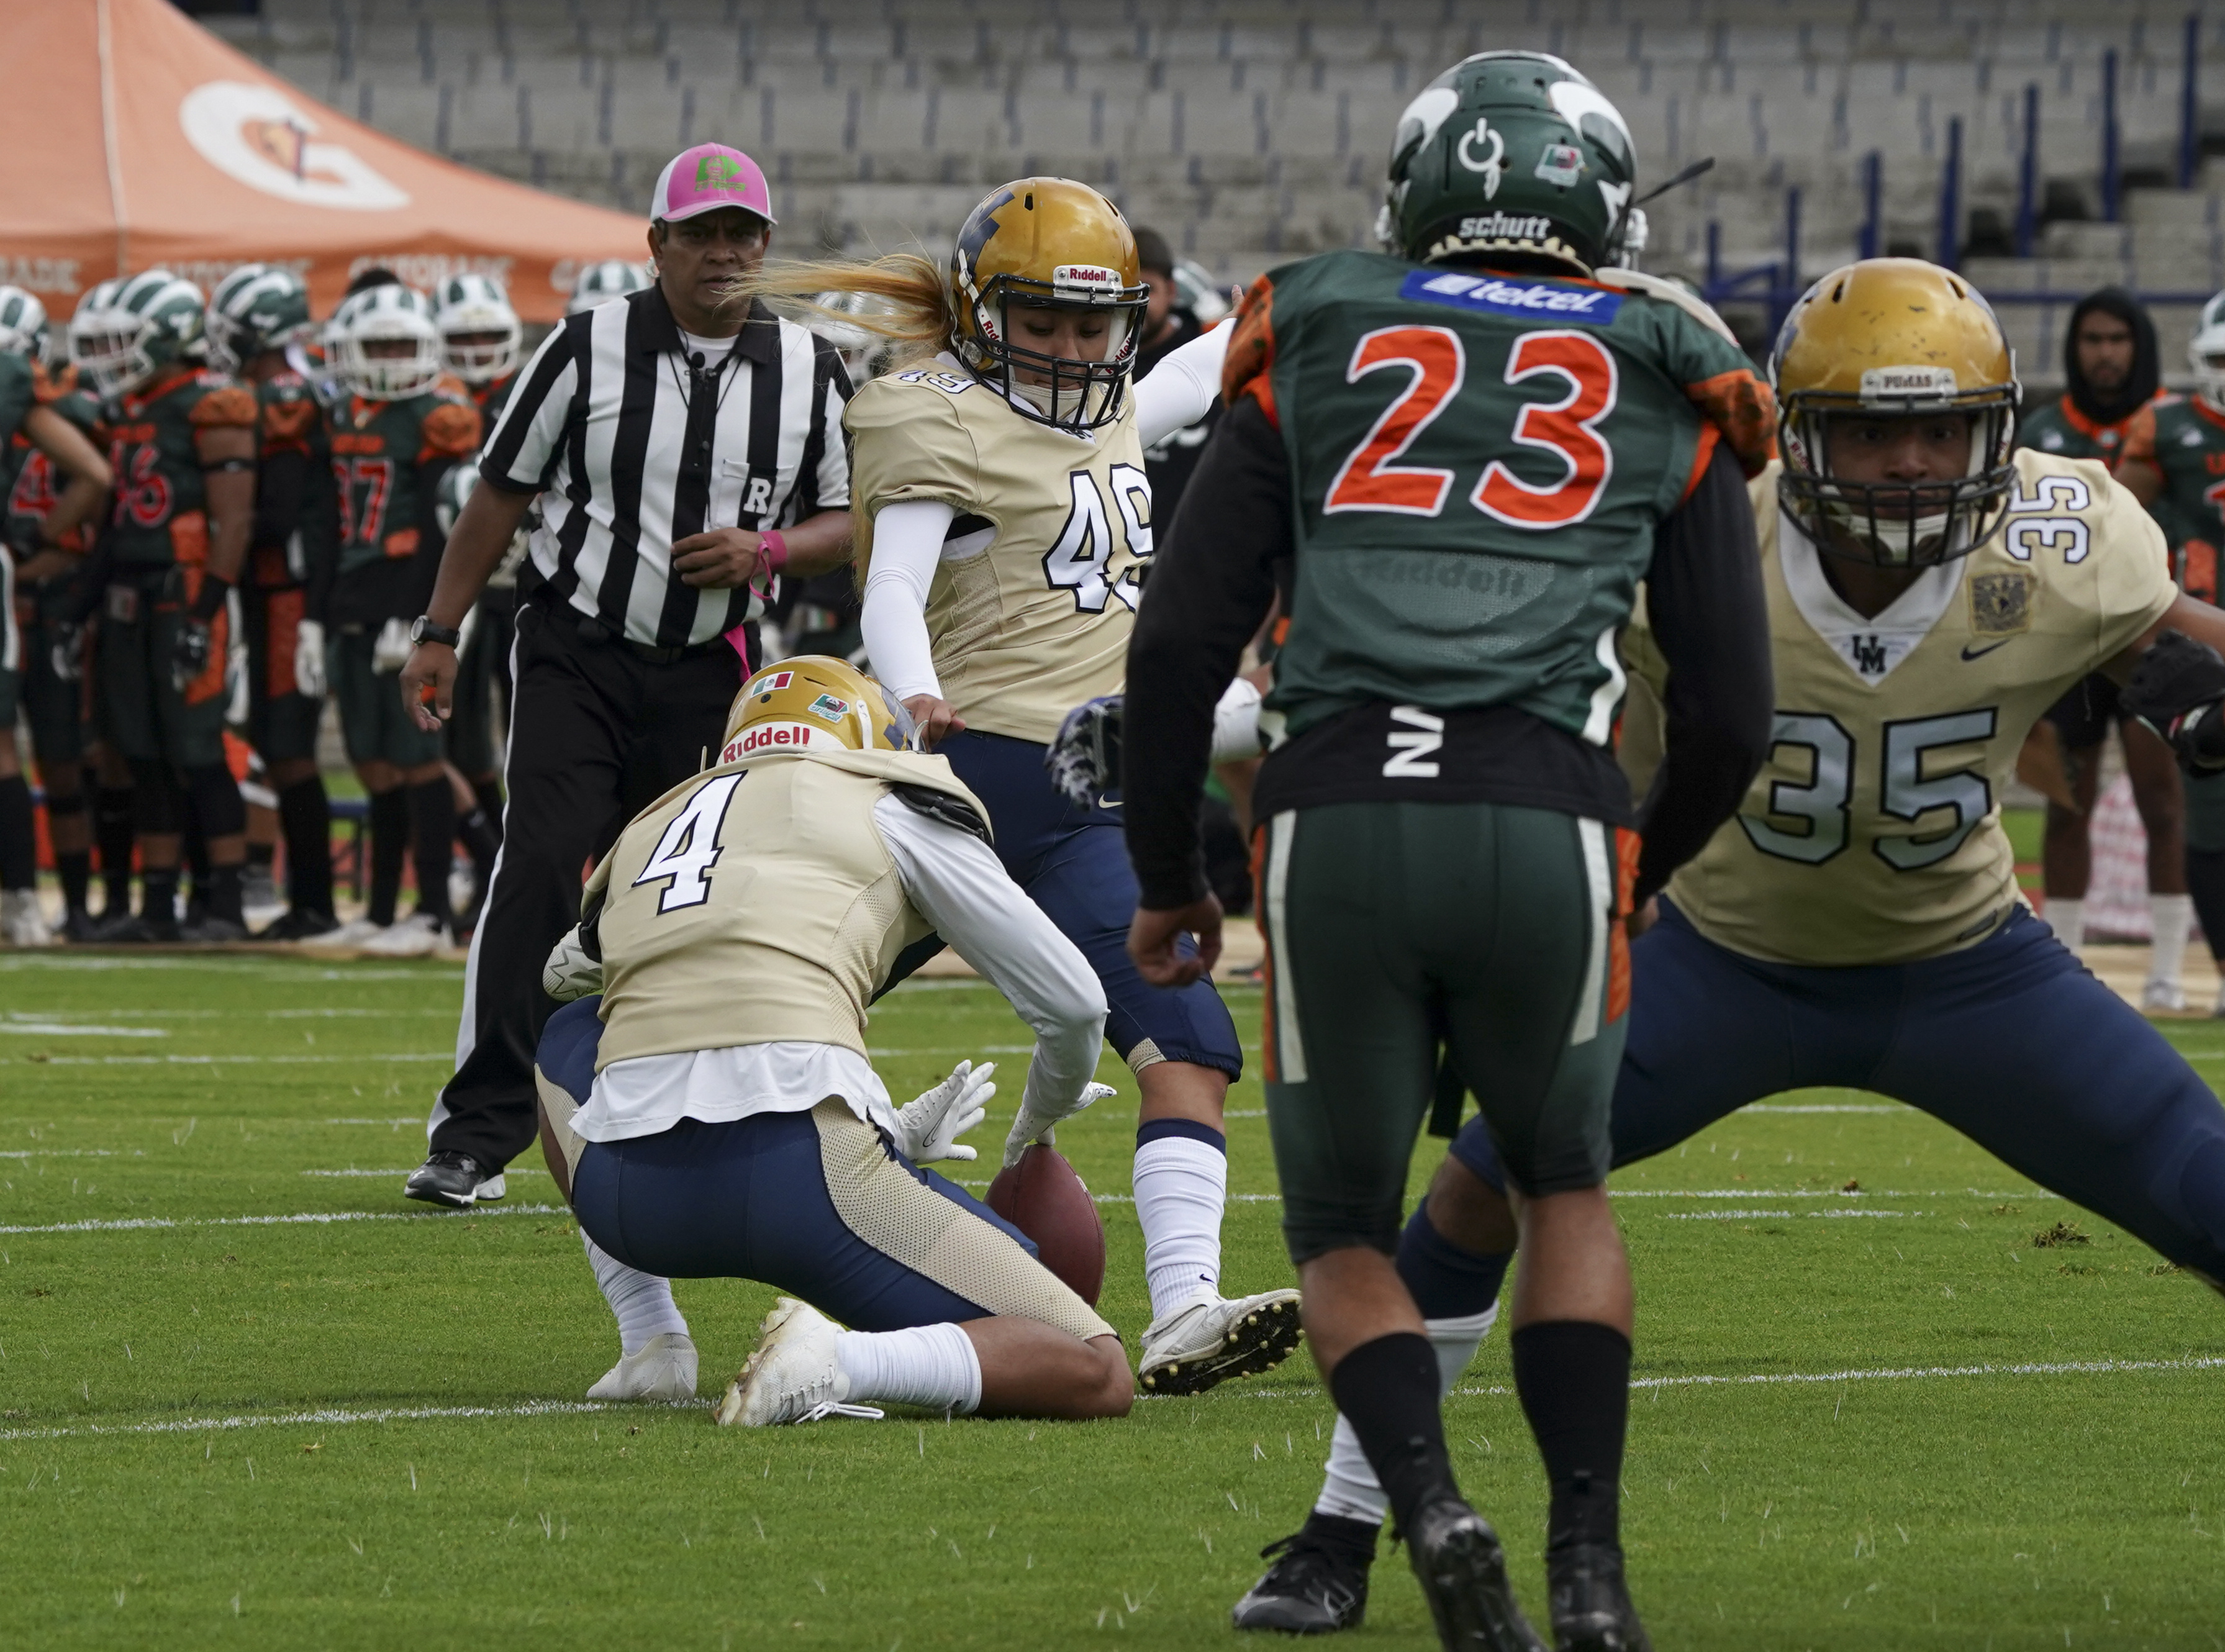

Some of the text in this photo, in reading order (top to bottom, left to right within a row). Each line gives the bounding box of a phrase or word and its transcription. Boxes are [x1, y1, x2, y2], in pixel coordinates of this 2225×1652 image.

[1458, 210, 1551, 240] schutt
[1070, 268, 1107, 281] Riddell
[1323, 324, 1618, 529] 23
[331, 456, 396, 543] 17
[743, 477, 771, 515] R
[1041, 462, 1154, 614] 49
[2006, 474, 2091, 564] 35
[723, 726, 810, 764] Riddell
[1739, 706, 1998, 870] 35
[631, 769, 748, 916] 4
